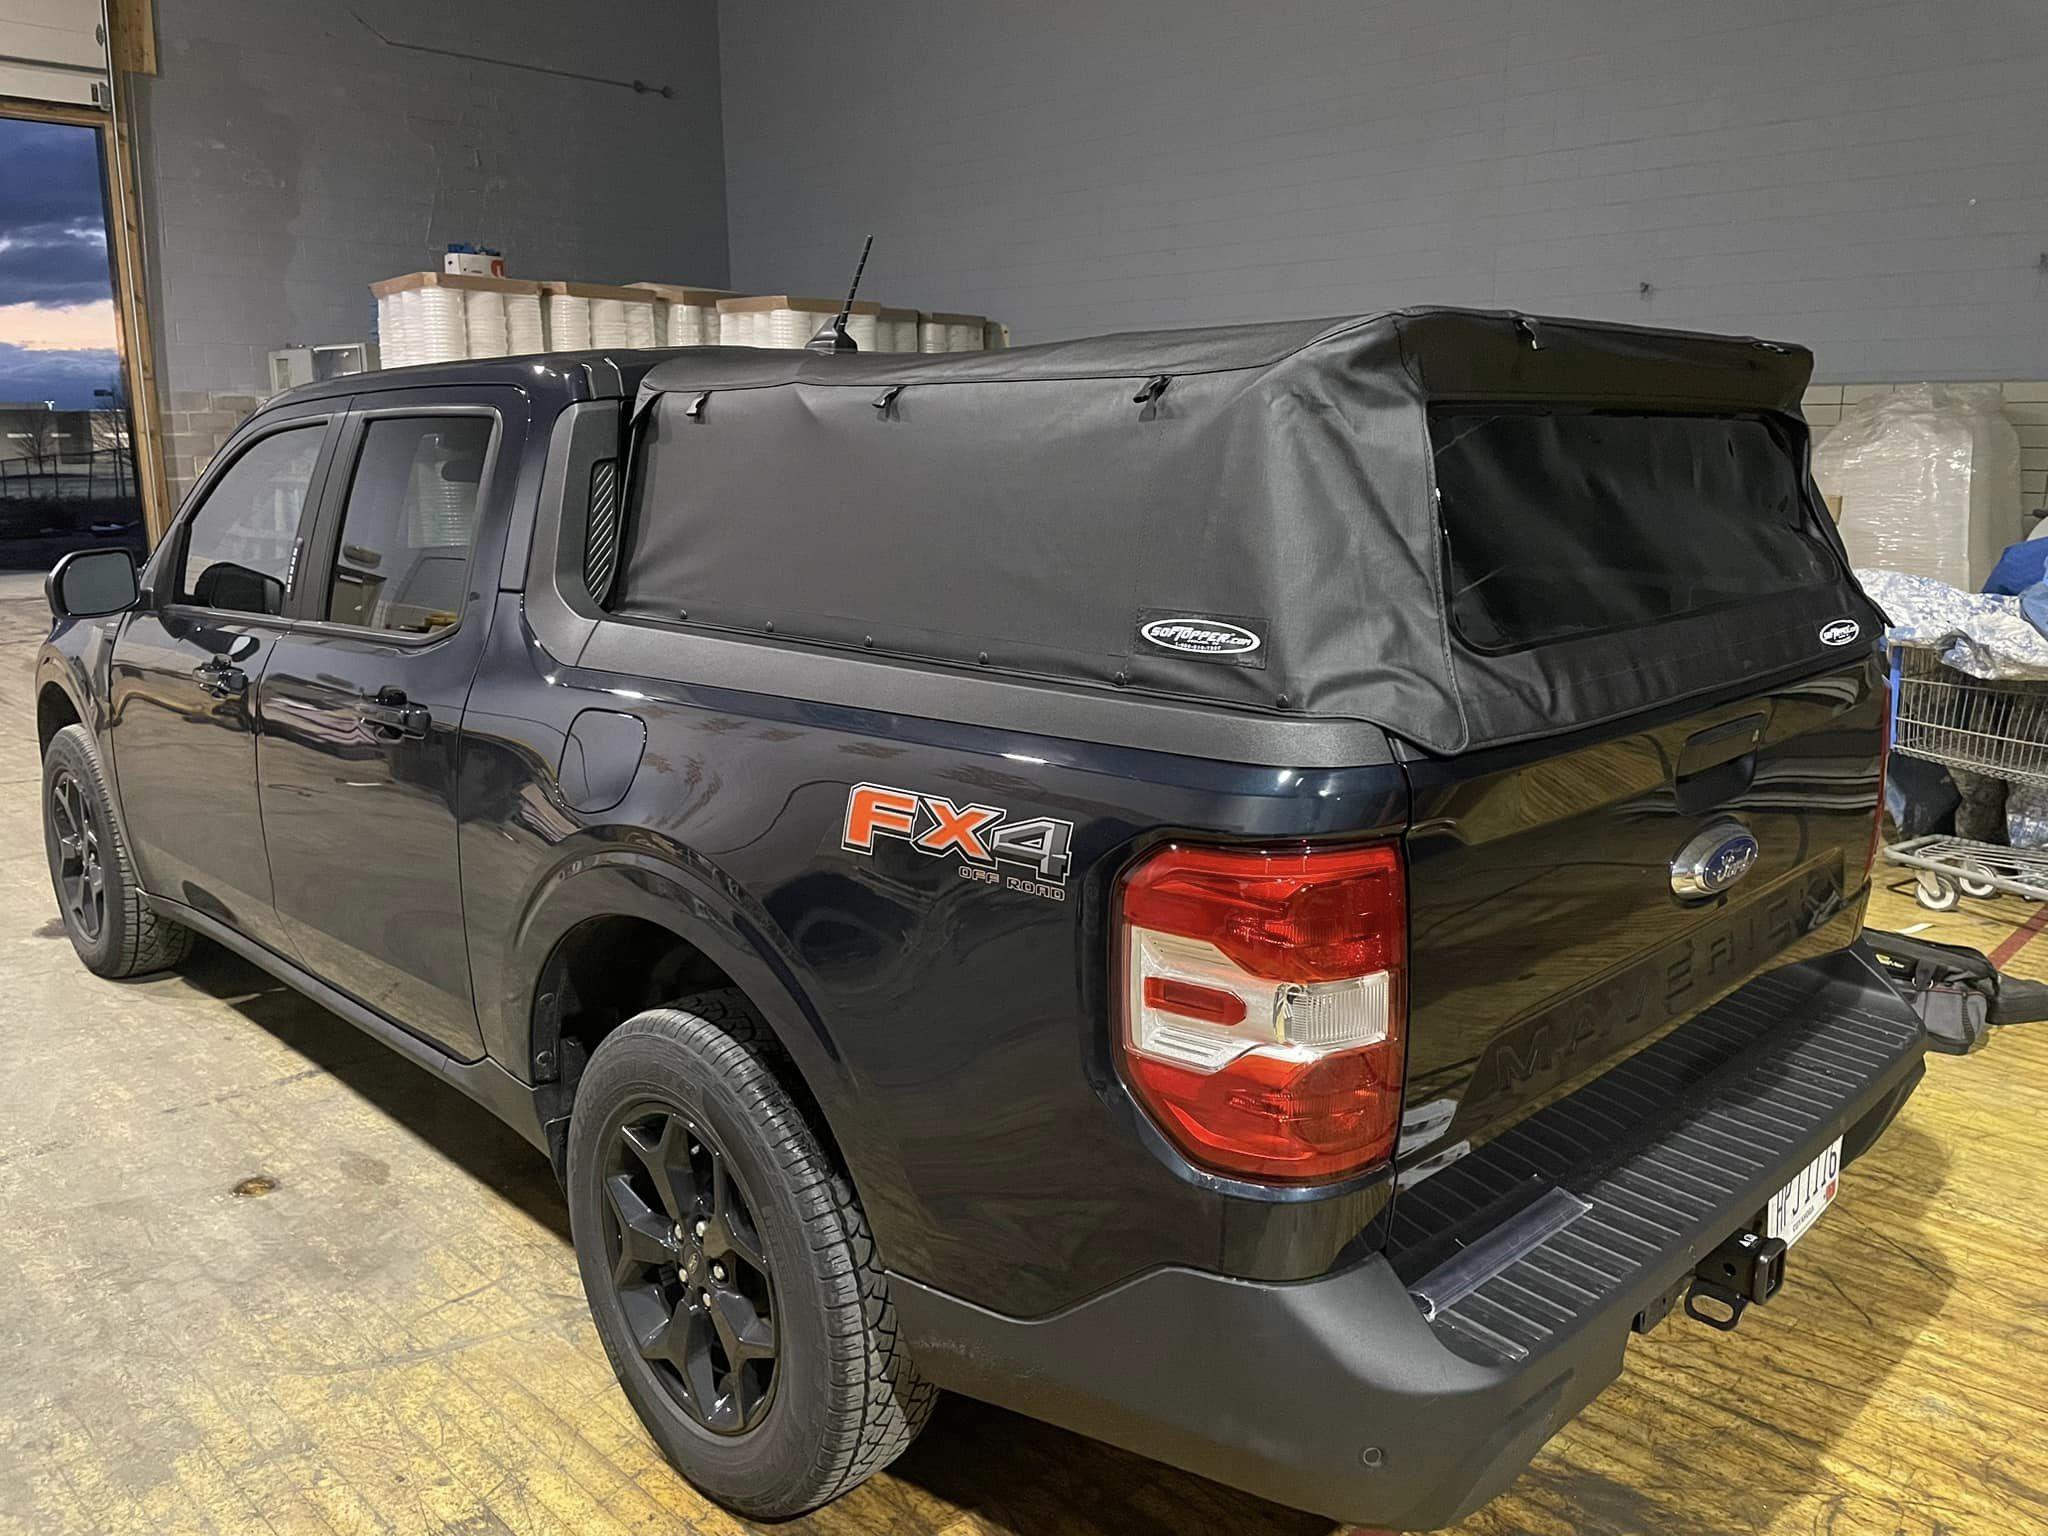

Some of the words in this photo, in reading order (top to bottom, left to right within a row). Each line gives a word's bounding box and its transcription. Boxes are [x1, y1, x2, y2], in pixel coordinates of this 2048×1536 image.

[841, 781, 1075, 886] FX4
[1712, 847, 1752, 882] Ford
[959, 865, 1000, 884] OFF
[1007, 876, 1066, 901] ROAD
[1497, 868, 1842, 1091] MAVERICK
